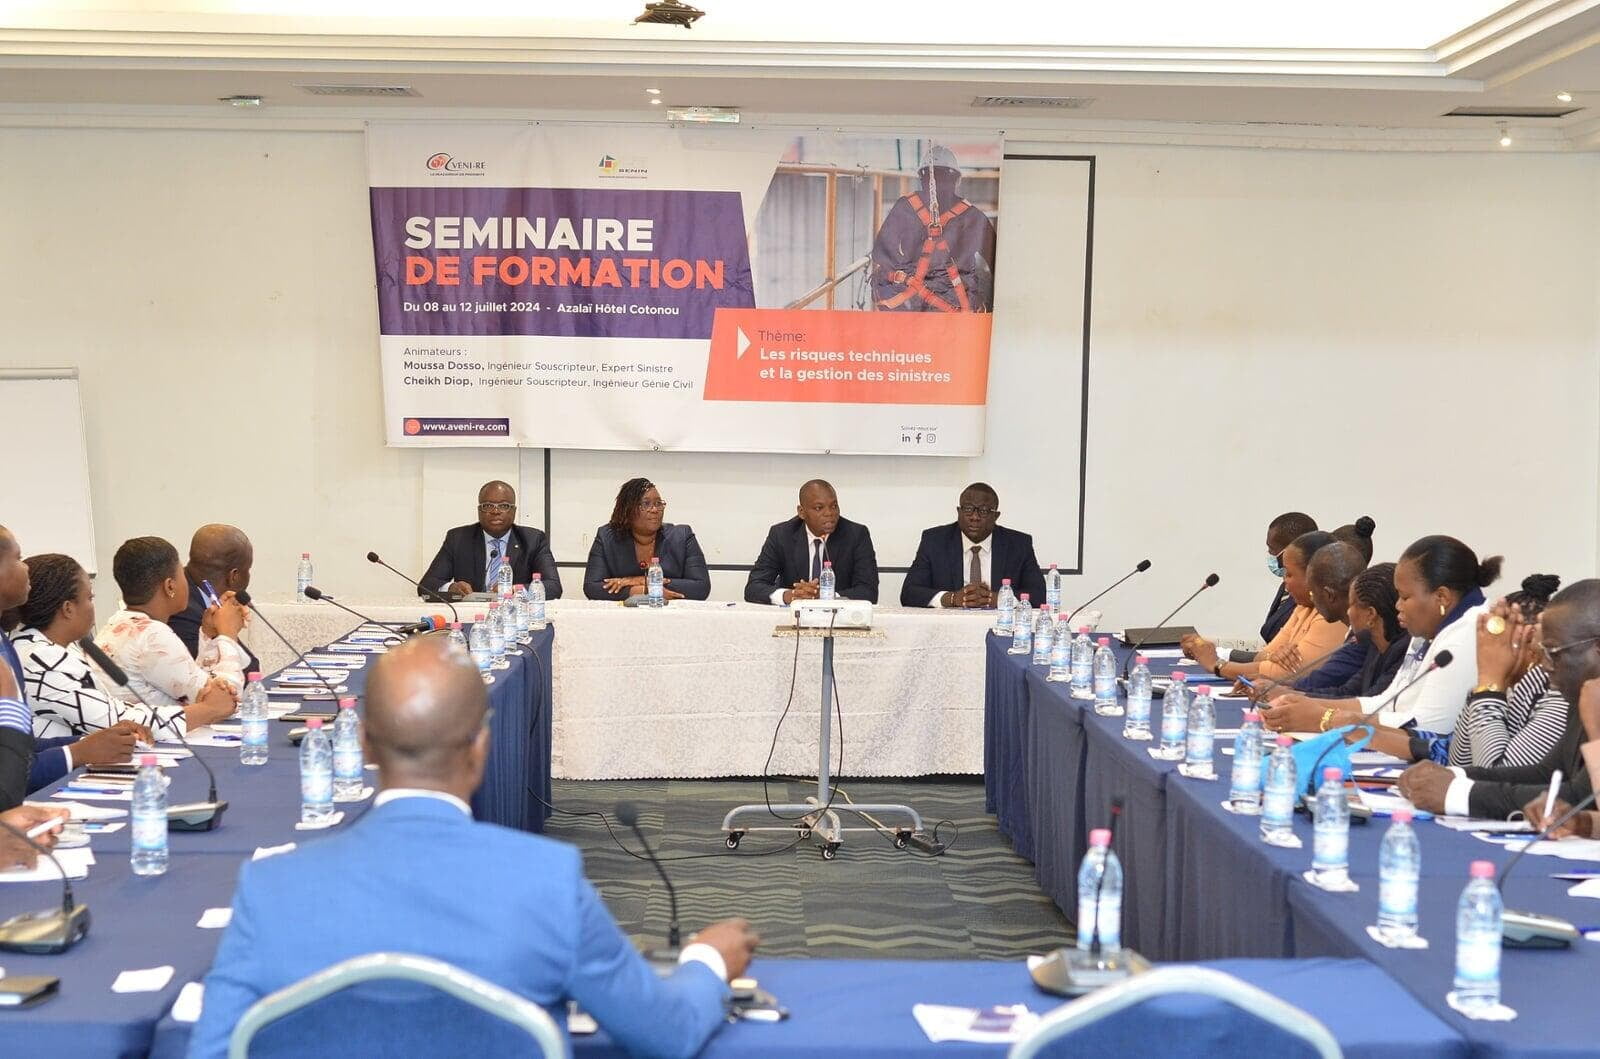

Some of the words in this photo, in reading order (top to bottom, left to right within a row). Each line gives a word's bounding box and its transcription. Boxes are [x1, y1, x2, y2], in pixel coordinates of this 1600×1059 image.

[404, 216, 654, 252] SEMINAIRE
[405, 255, 460, 286] DE
[472, 256, 725, 290] FORMATION
[403, 302, 420, 312] Du
[423, 302, 439, 312] 08
[442, 304, 457, 312] au
[460, 302, 472, 312] 12
[474, 302, 507, 314] juillet
[509, 302, 541, 312] 2024
[557, 303, 592, 313] Azalaï
[595, 303, 627, 314] Hôtel
[629, 304, 680, 315] Cotonou
[758, 330, 807, 343] Thème:
[403, 347, 462, 356] Animateurs
[760, 348, 786, 361] Les
[790, 349, 845, 364] risques
[849, 350, 932, 366] techniques
[403, 361, 445, 370] Moussa
[447, 361, 485, 371] Dosso,
[487, 361, 532, 371] Ingénieur
[535, 362, 599, 373] Souscripteur,
[601, 363, 634, 373] Expert
[637, 363, 674, 373] Sinistre
[759, 368, 775, 379] et
[779, 367, 791, 379] la
[797, 368, 853, 382] gestion
[857, 368, 884, 381] des
[887, 369, 951, 383] sinistres
[403, 376, 441, 386] Cheikh
[444, 376, 473, 387] Diop,
[479, 377, 523, 387] Ingénieur
[593, 379, 639, 389] Ingénieur
[641, 379, 671, 389] Génie
[673, 380, 694, 389] Civil
[422, 422, 508, 431] www.aveni-re.com
